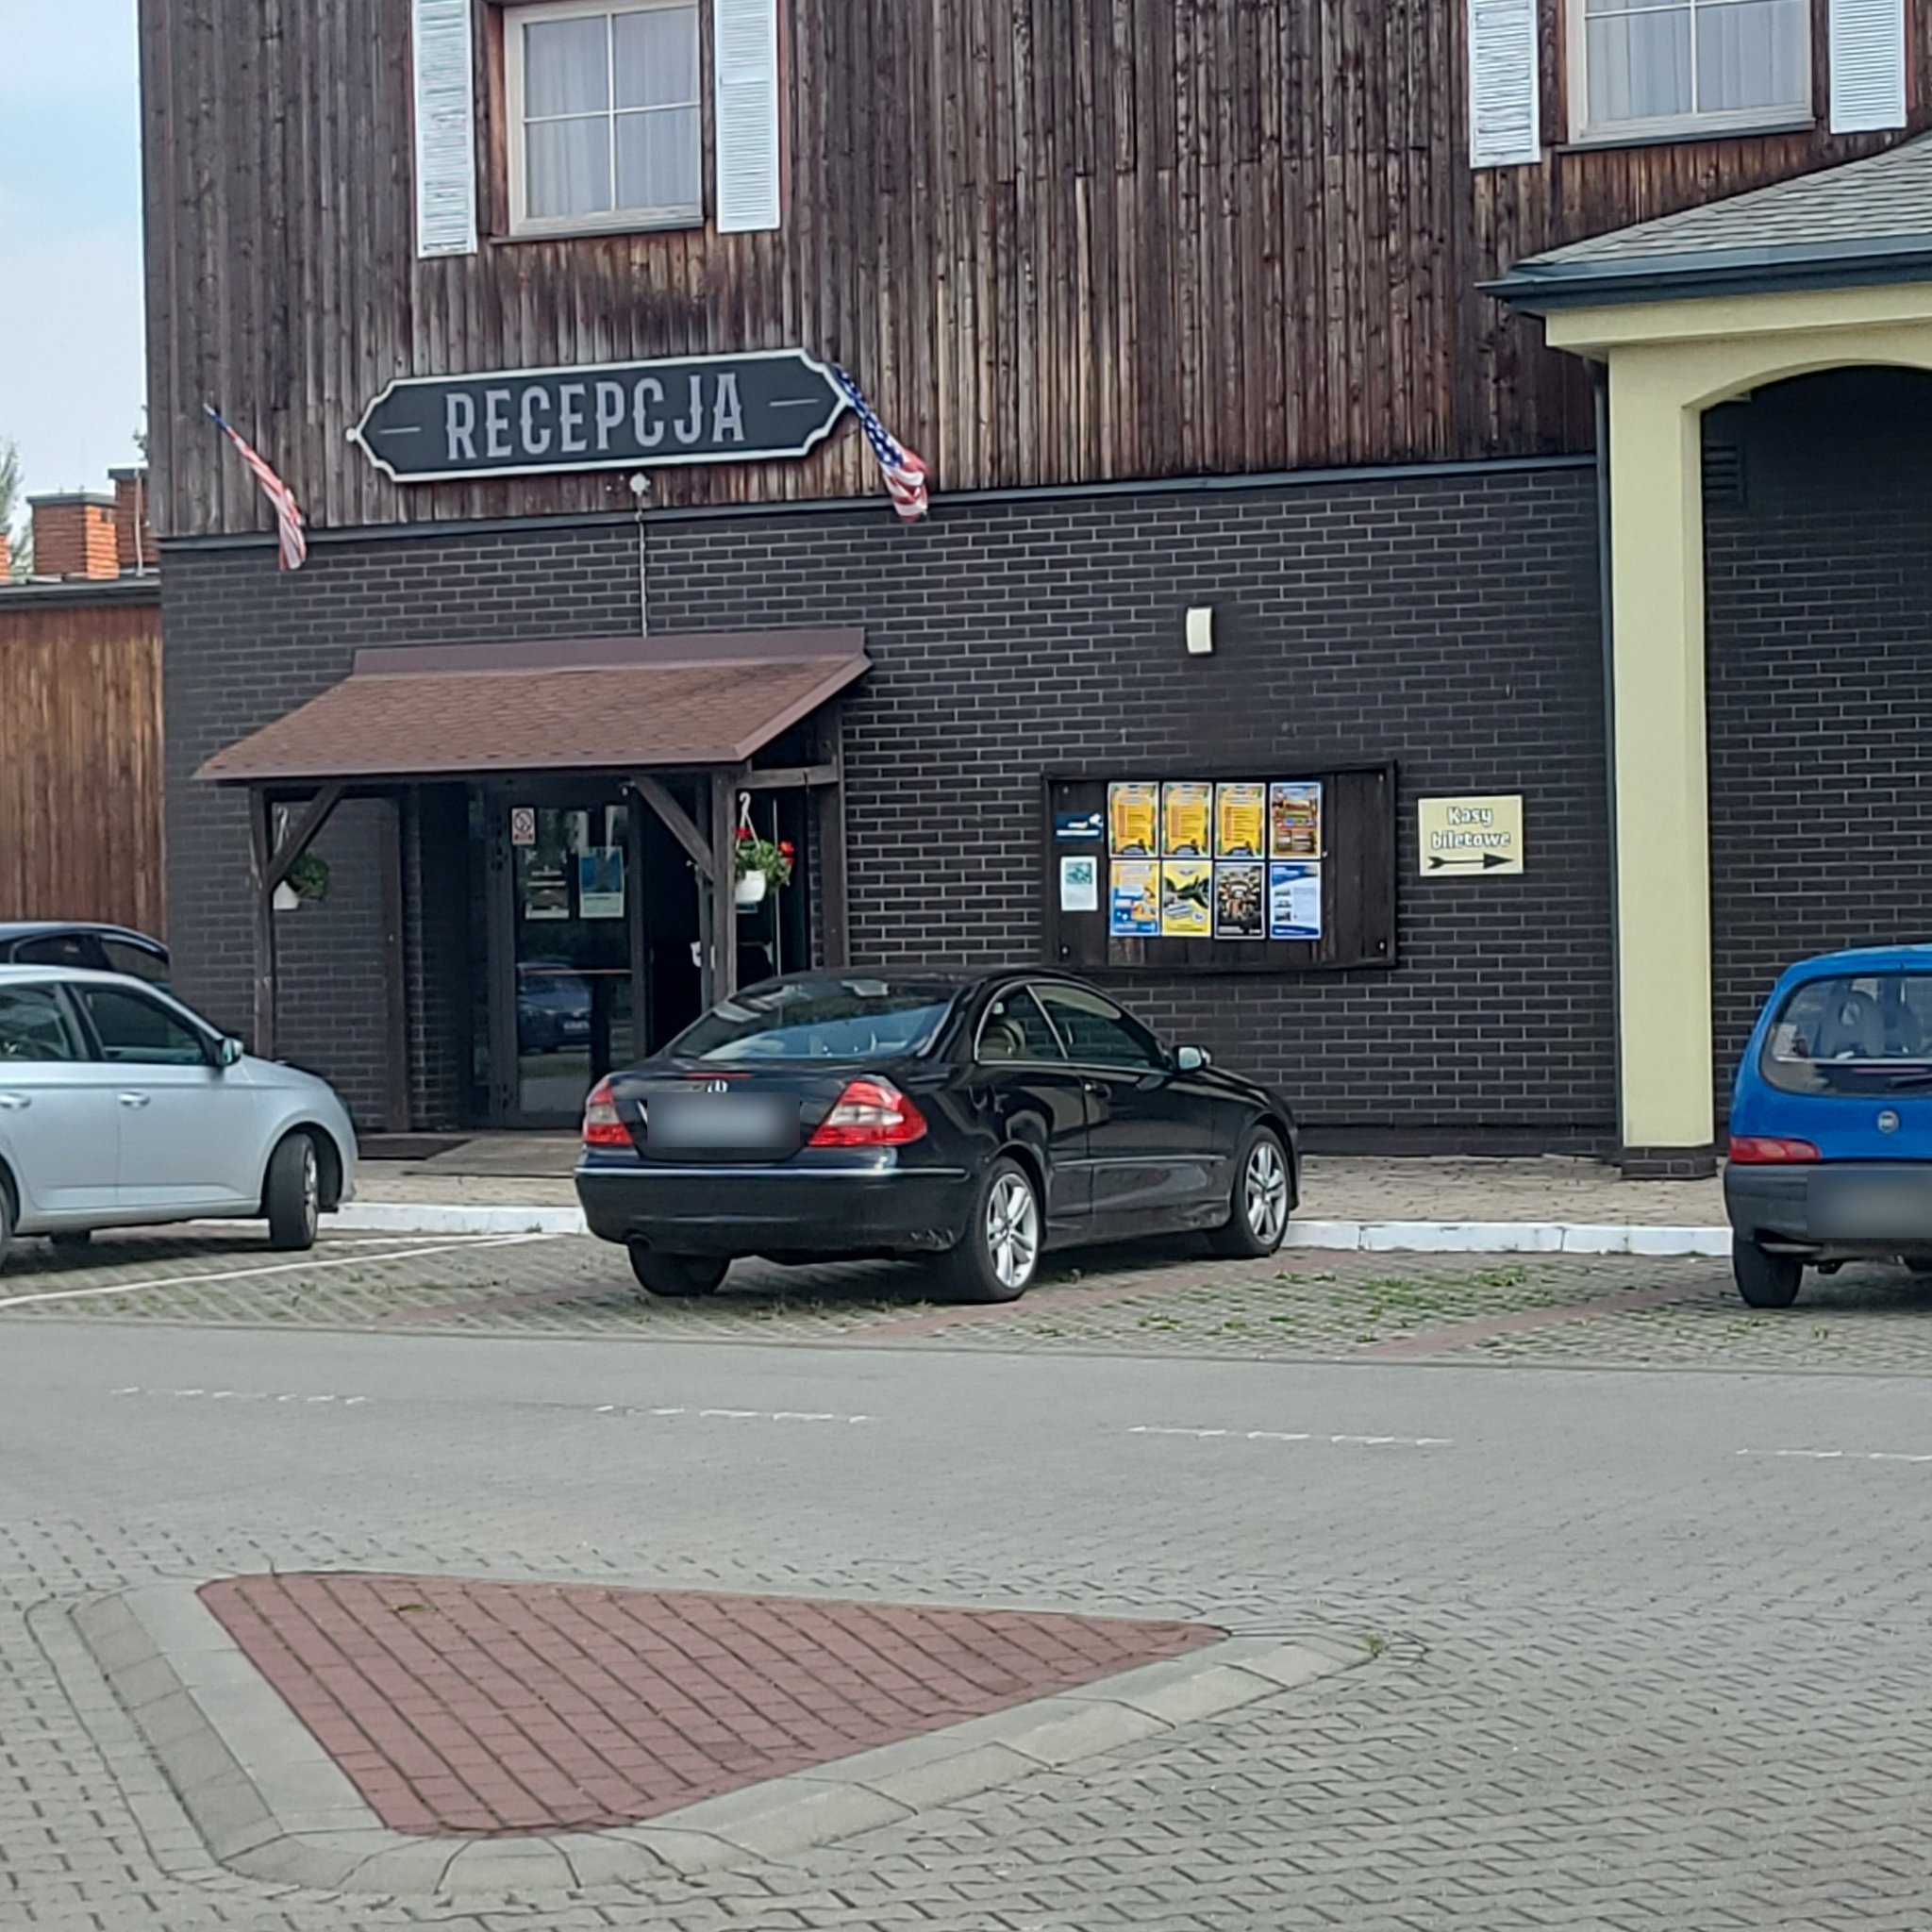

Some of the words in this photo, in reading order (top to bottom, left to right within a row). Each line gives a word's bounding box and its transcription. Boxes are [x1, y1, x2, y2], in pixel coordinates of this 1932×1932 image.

[446, 373, 744, 459] RECEPCJA
[1447, 807, 1492, 827] Kasy
[1431, 830, 1510, 849] biletowe
